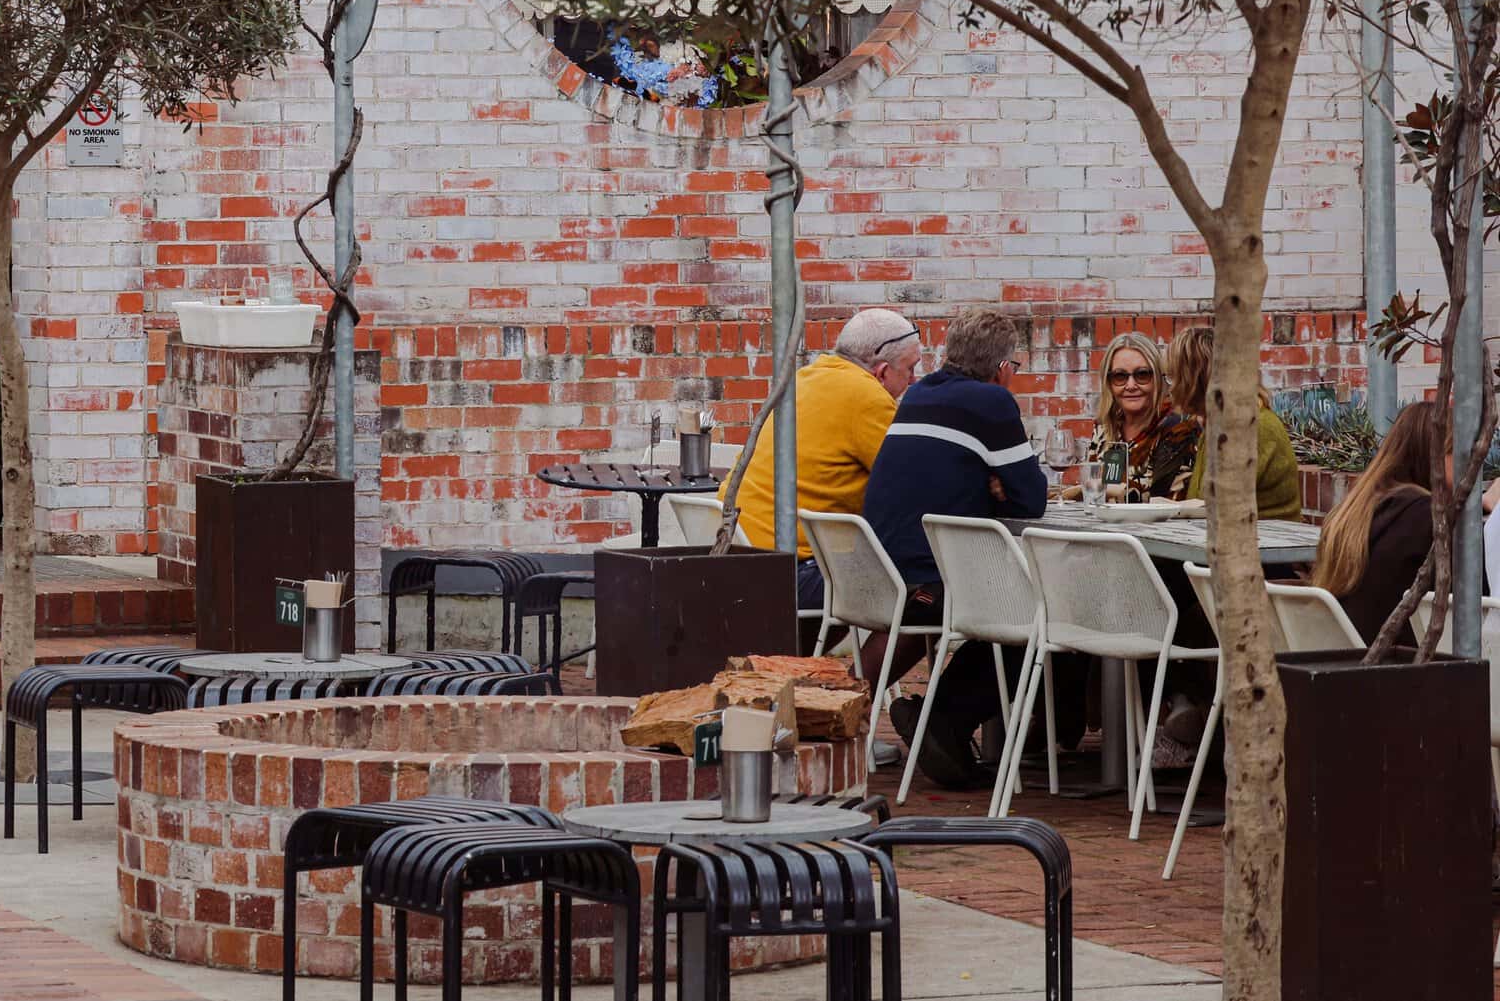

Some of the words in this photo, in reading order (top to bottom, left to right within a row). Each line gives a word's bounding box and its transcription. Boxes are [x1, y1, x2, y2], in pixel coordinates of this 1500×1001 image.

[69, 128, 81, 136] NO
[82, 128, 120, 136] SMOKING
[84, 136, 105, 144] AREA
[1105, 463, 1120, 481] 701
[280, 600, 299, 622] 718
[701, 736, 718, 761] 71
